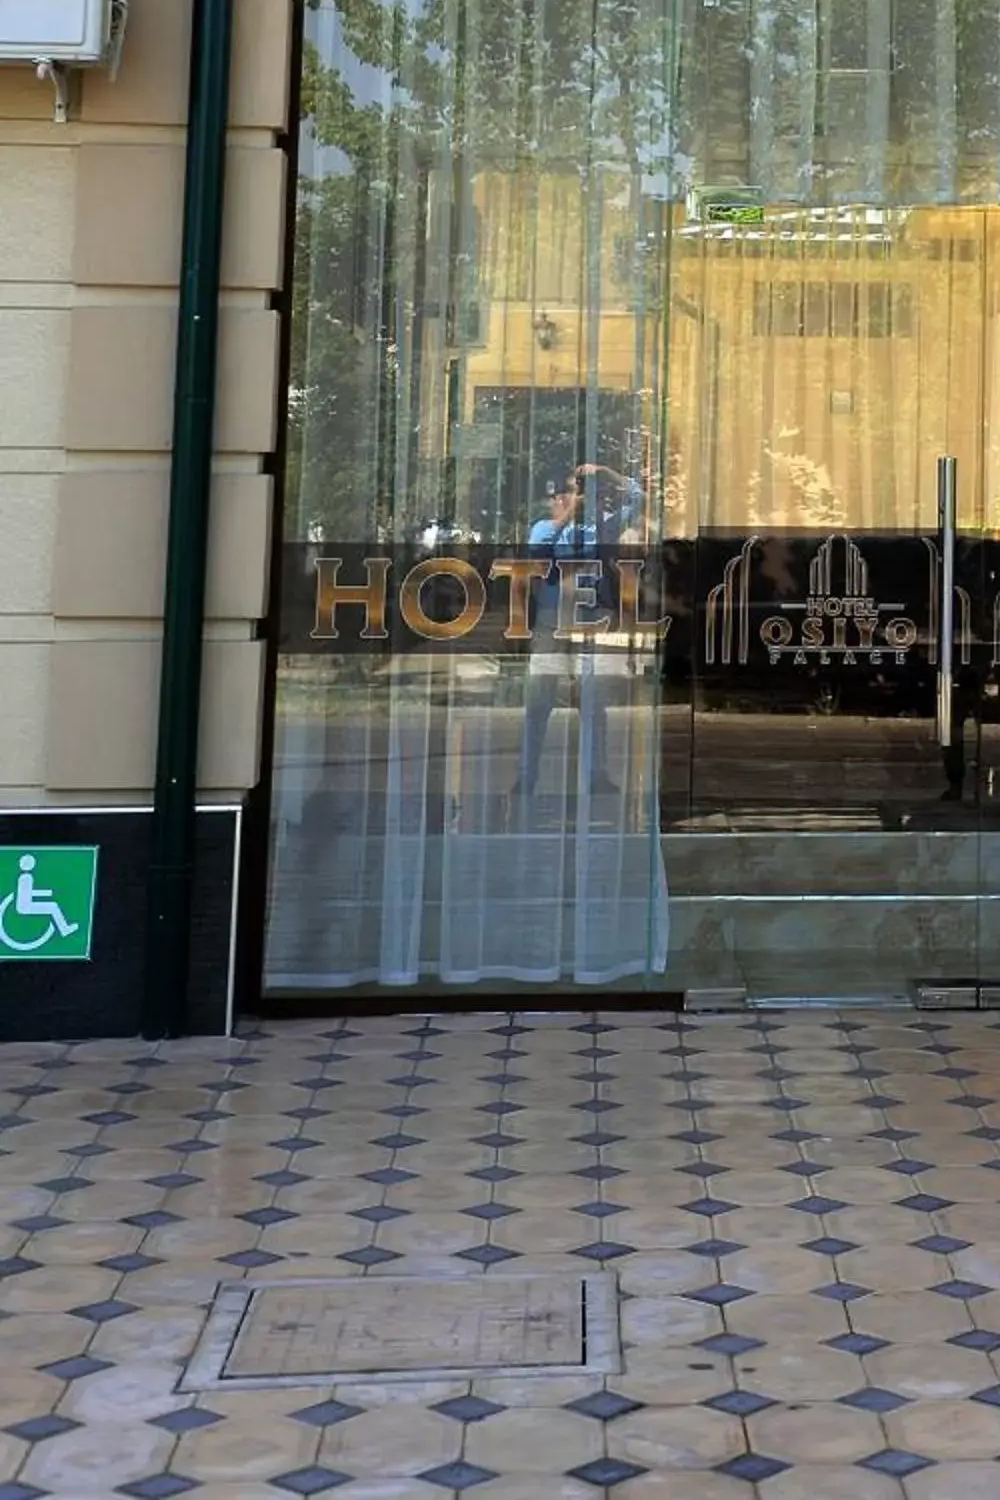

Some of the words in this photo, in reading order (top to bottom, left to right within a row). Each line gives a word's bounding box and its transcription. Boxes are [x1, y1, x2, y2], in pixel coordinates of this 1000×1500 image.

[309, 557, 672, 640] HOTEL
[806, 598, 879, 617] HOTEL
[760, 616, 917, 647] OSIYO
[769, 649, 907, 665] PALACE
